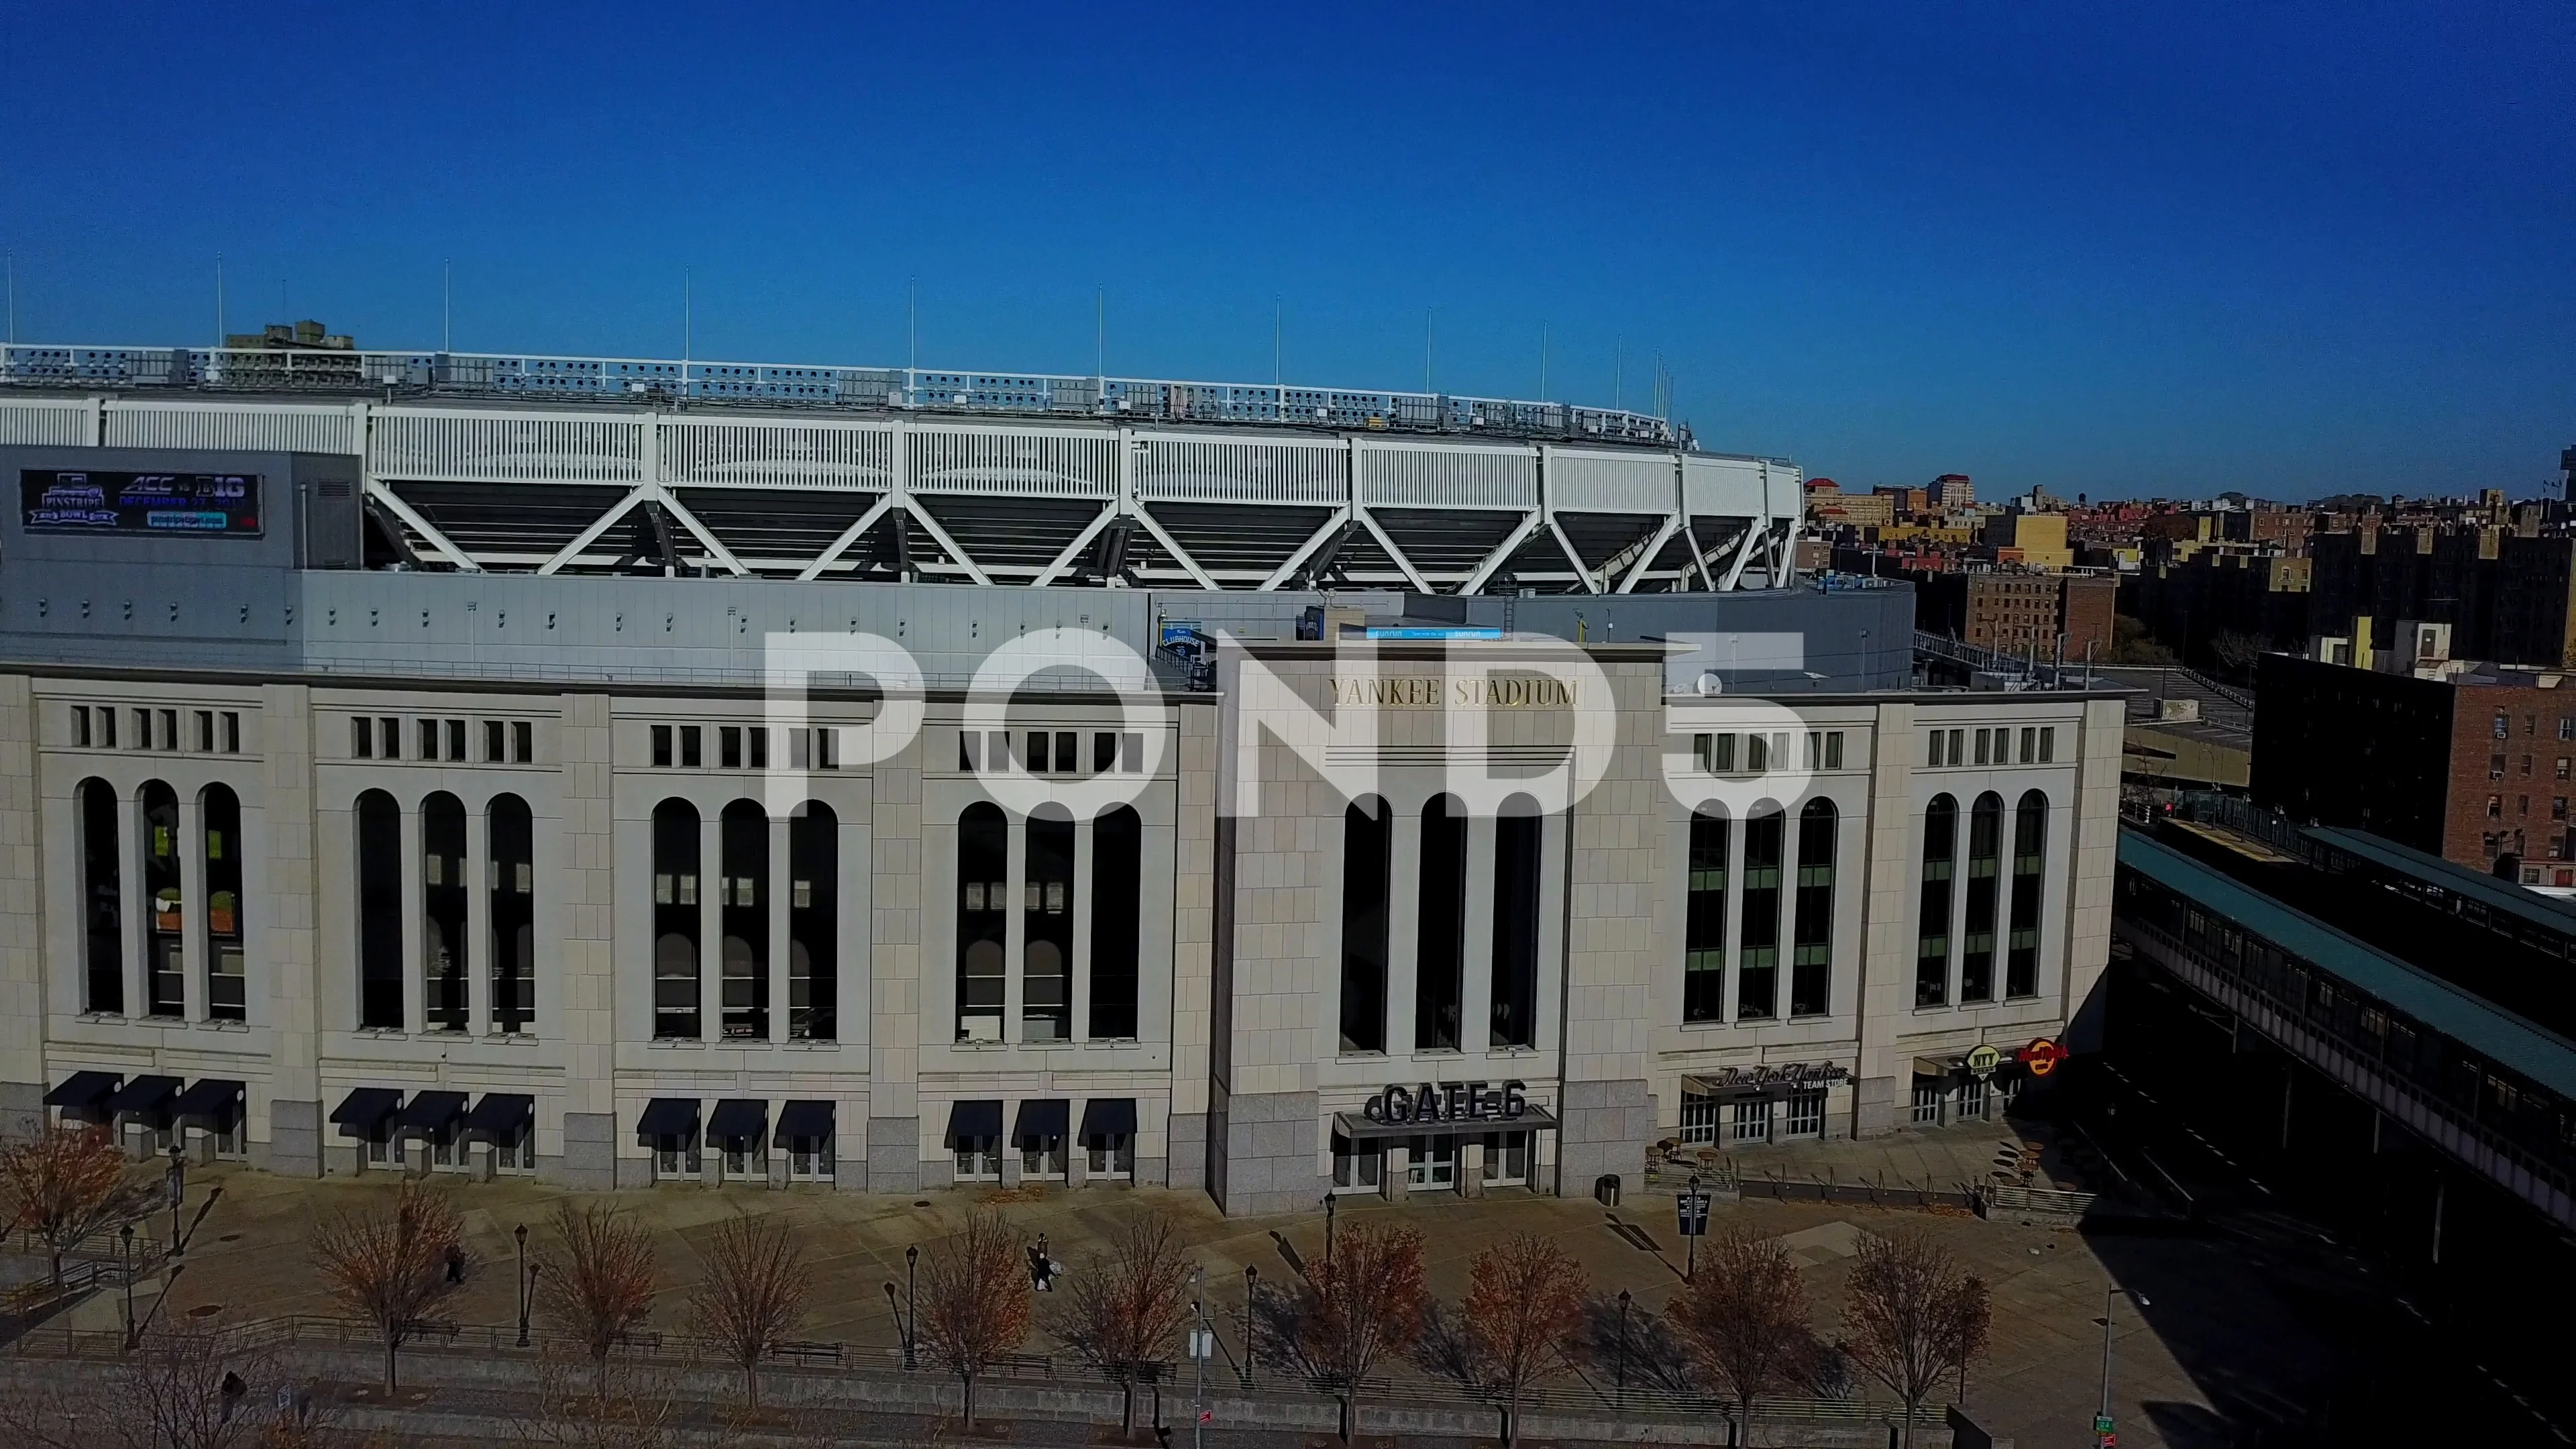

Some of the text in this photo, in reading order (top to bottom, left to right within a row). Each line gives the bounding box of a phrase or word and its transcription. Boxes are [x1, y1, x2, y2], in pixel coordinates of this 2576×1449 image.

[121, 476, 176, 493] ACC
[46, 497, 101, 508] PINSTRIPE
[119, 496, 187, 506] DECEMBER
[59, 510, 88, 519] BOWL
[1162, 635, 1200, 647] CLUBHOUSE
[1328, 678, 1578, 707] YANKEE STADIUM
[1973, 1053, 1996, 1067] NYY
[1717, 1067, 1755, 1087] New
[1754, 1064, 1792, 1088] York
[1803, 1078, 1849, 1089] TEAM STORE
[1382, 1079, 1527, 1123] GATE 6
